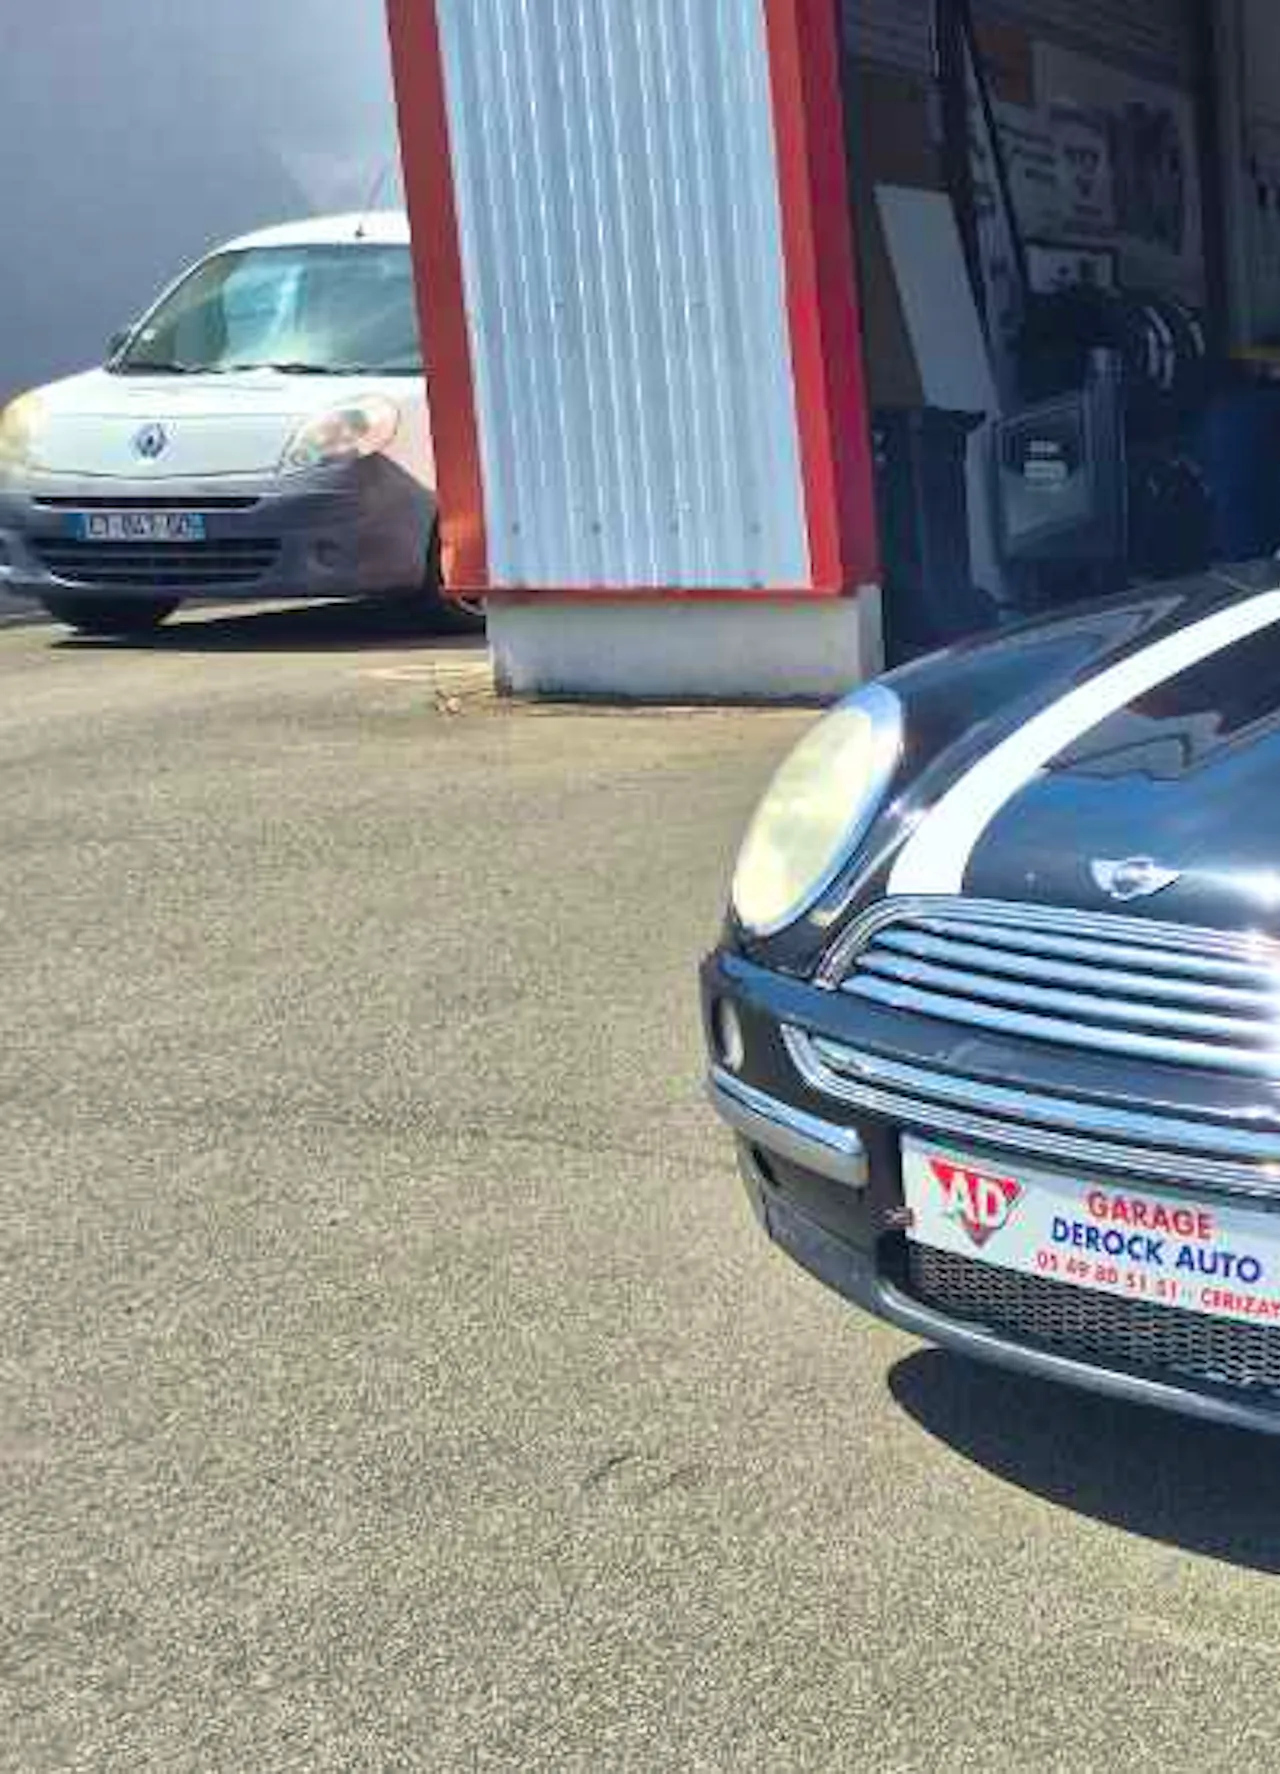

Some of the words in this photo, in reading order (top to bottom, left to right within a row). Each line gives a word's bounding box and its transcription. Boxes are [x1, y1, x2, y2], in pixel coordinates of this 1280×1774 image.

[943, 1170, 1006, 1228] AD
[1087, 1190, 1215, 1240] GARAGE
[1036, 1251, 1058, 1272] 05
[1066, 1257, 1089, 1278] 49
[1126, 1271, 1147, 1291] 51
[1052, 1217, 1164, 1265] DEROCK
[1175, 1245, 1262, 1284] AUTO
